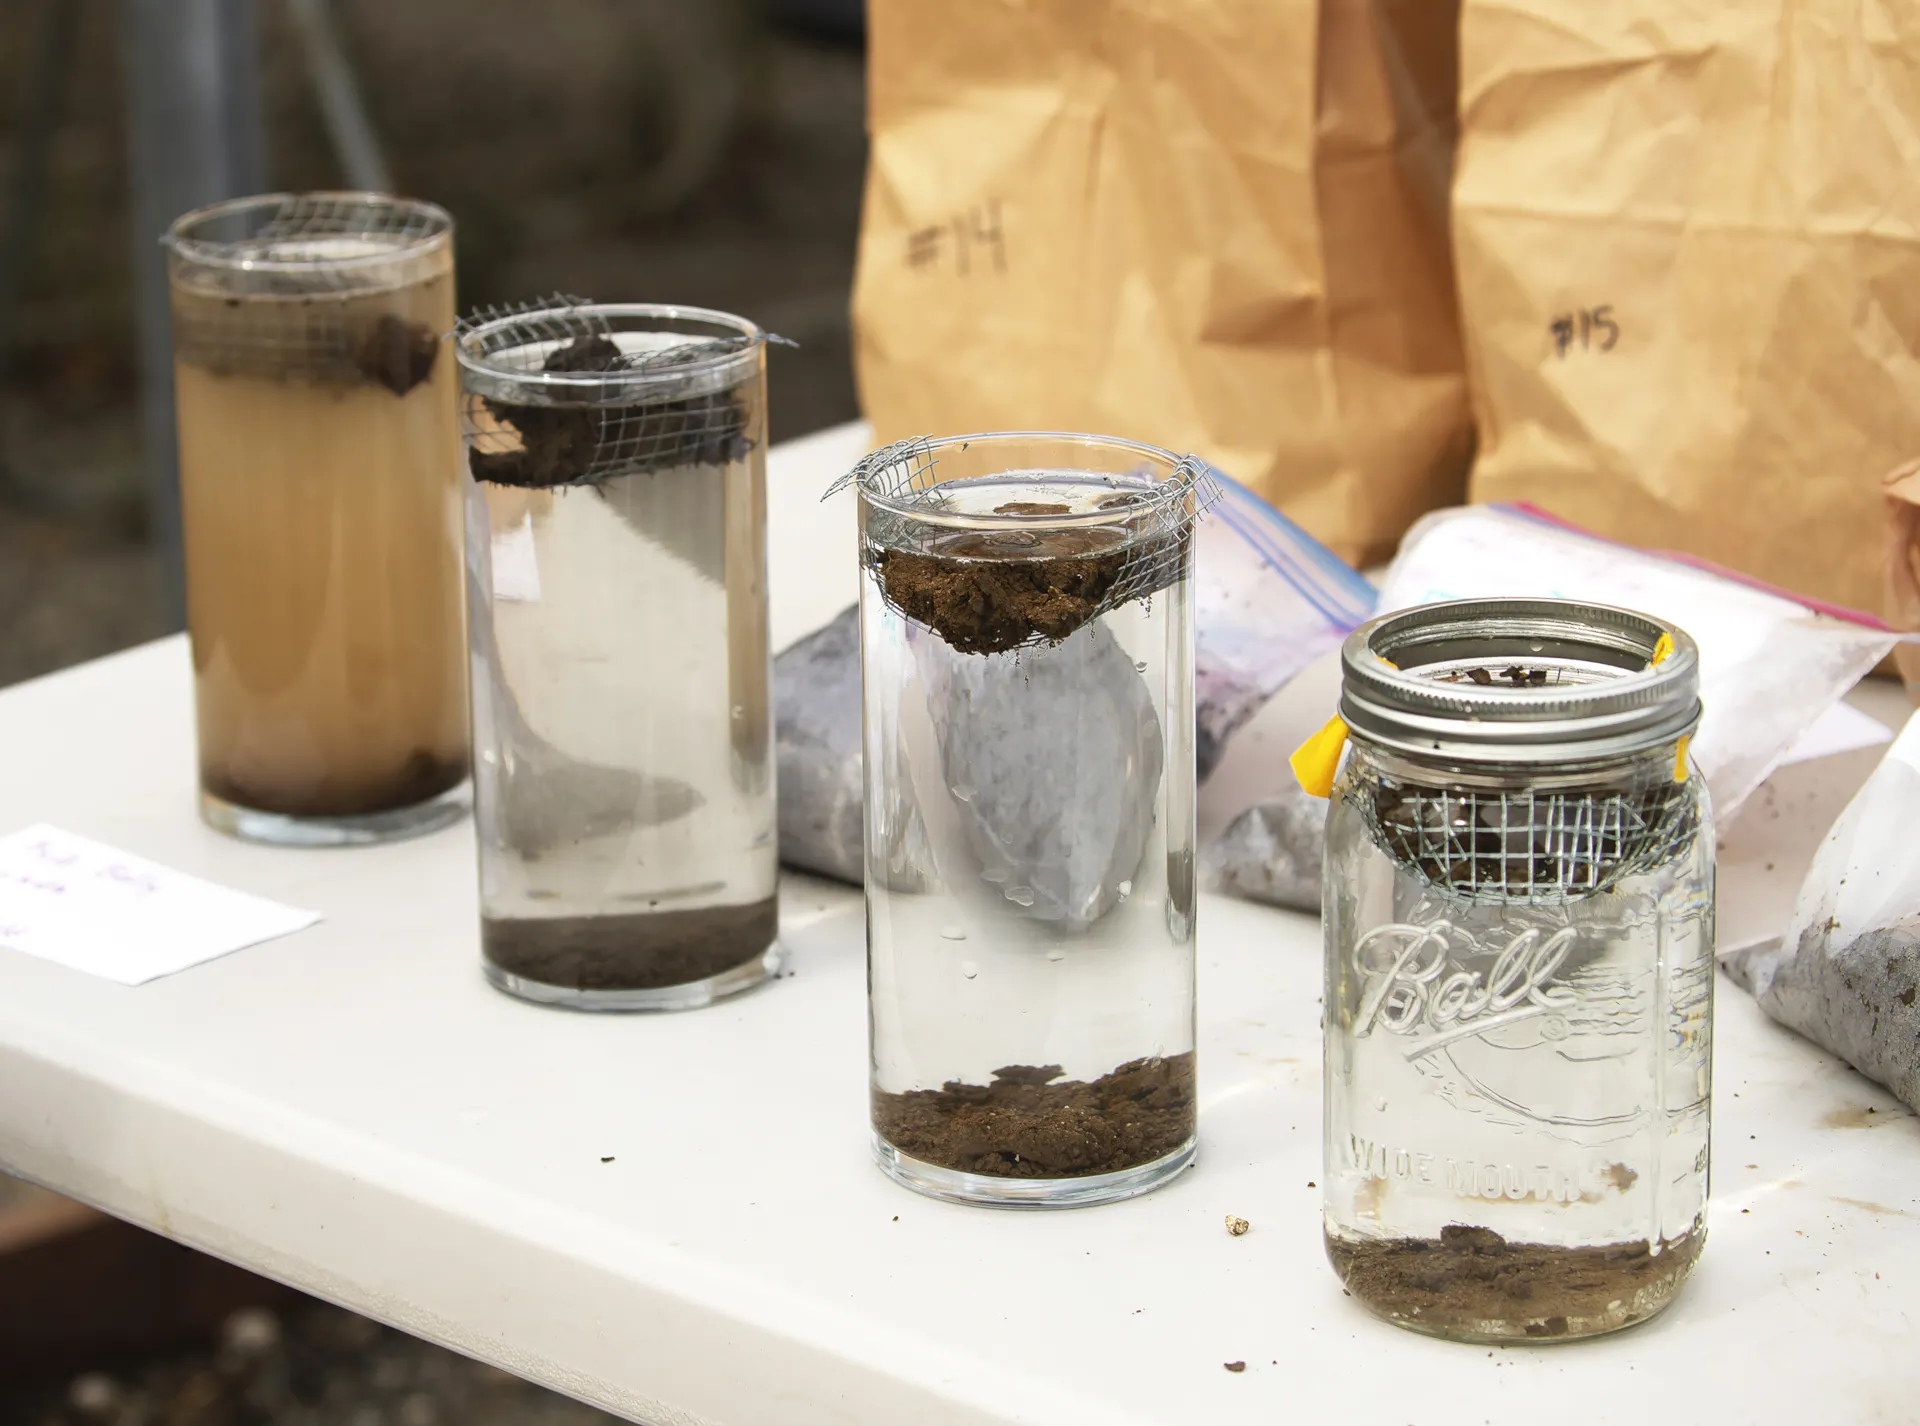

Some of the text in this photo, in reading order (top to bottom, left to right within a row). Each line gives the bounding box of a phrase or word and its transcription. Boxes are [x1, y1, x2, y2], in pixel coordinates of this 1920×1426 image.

[904, 199, 1008, 278] #14
[1549, 304, 1620, 361] #15
[1352, 919, 1578, 1040] Ball
[1349, 1133, 1582, 1201] WIDE MOUTH
